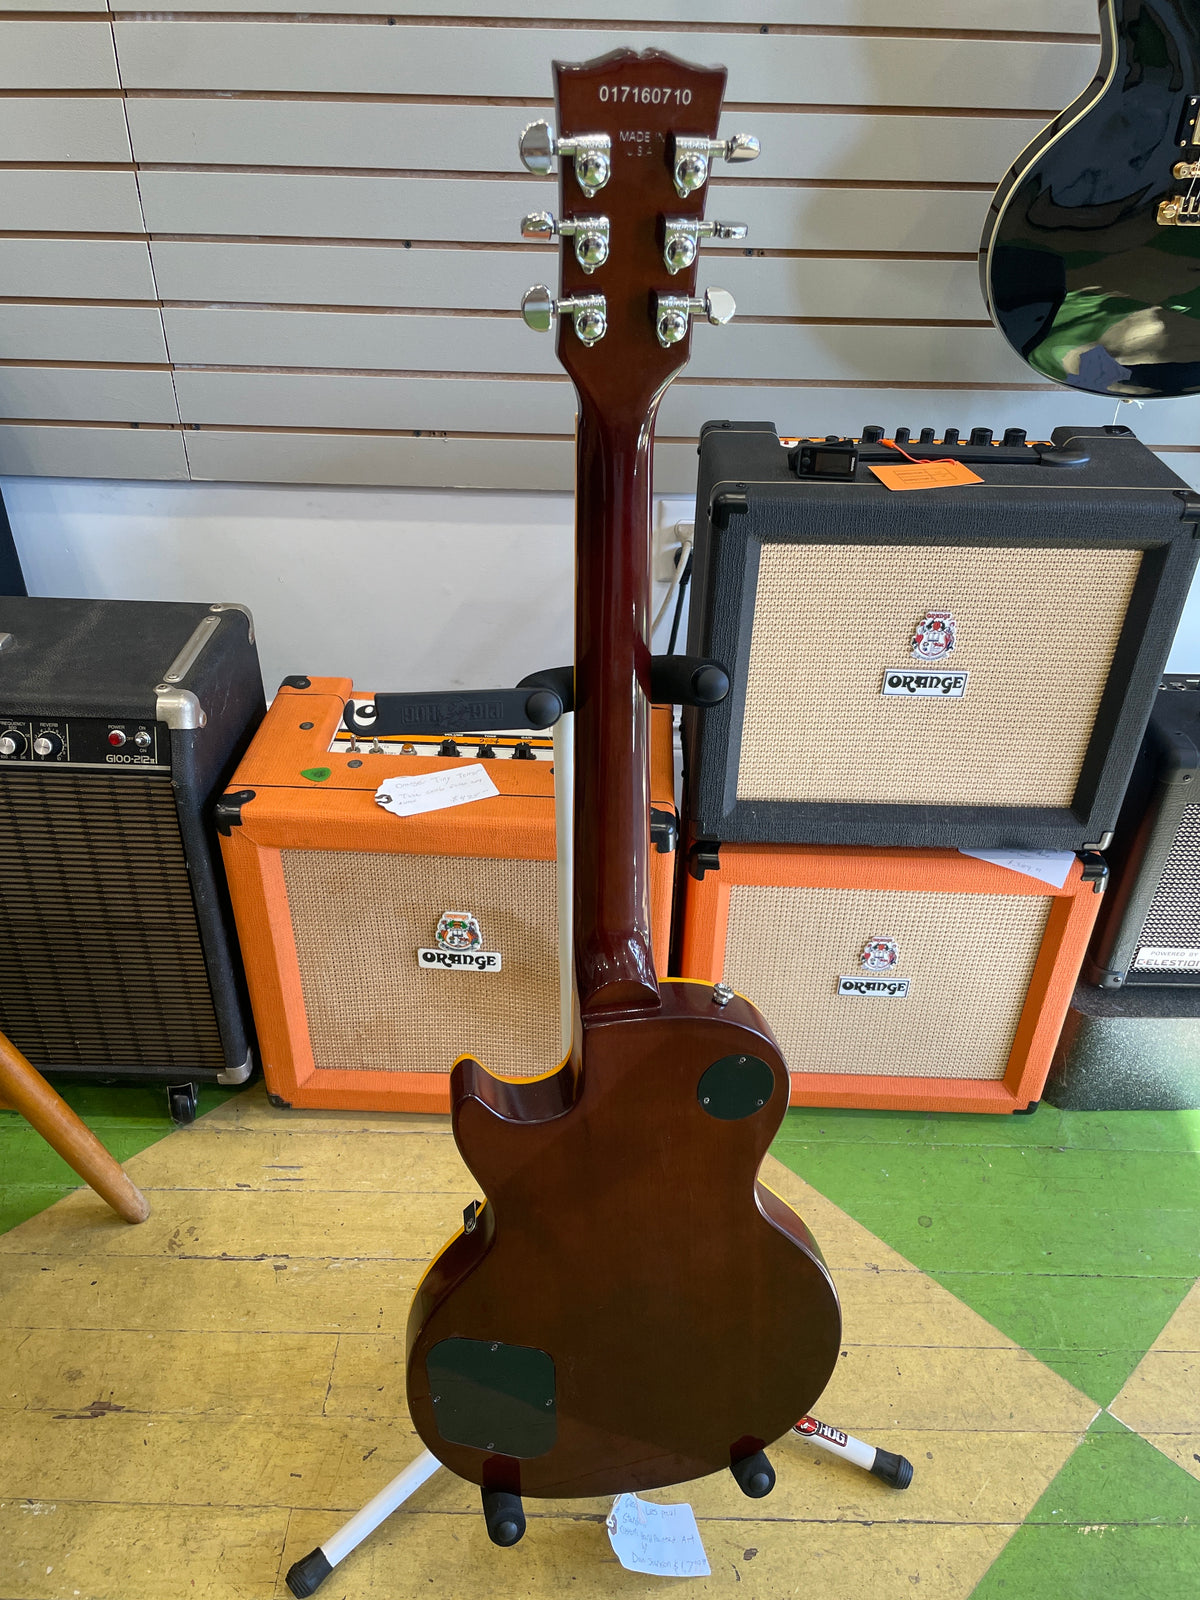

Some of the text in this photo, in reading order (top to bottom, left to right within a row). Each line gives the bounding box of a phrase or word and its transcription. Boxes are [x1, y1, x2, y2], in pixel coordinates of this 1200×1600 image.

[599, 86, 692, 105] 017160710
[619, 130, 651, 143] MADE
[888, 675, 964, 694] ORANGE
[422, 952, 497, 970] ORANGE
[842, 981, 907, 995] ORANGE
[819, 1423, 846, 1444] HOG
